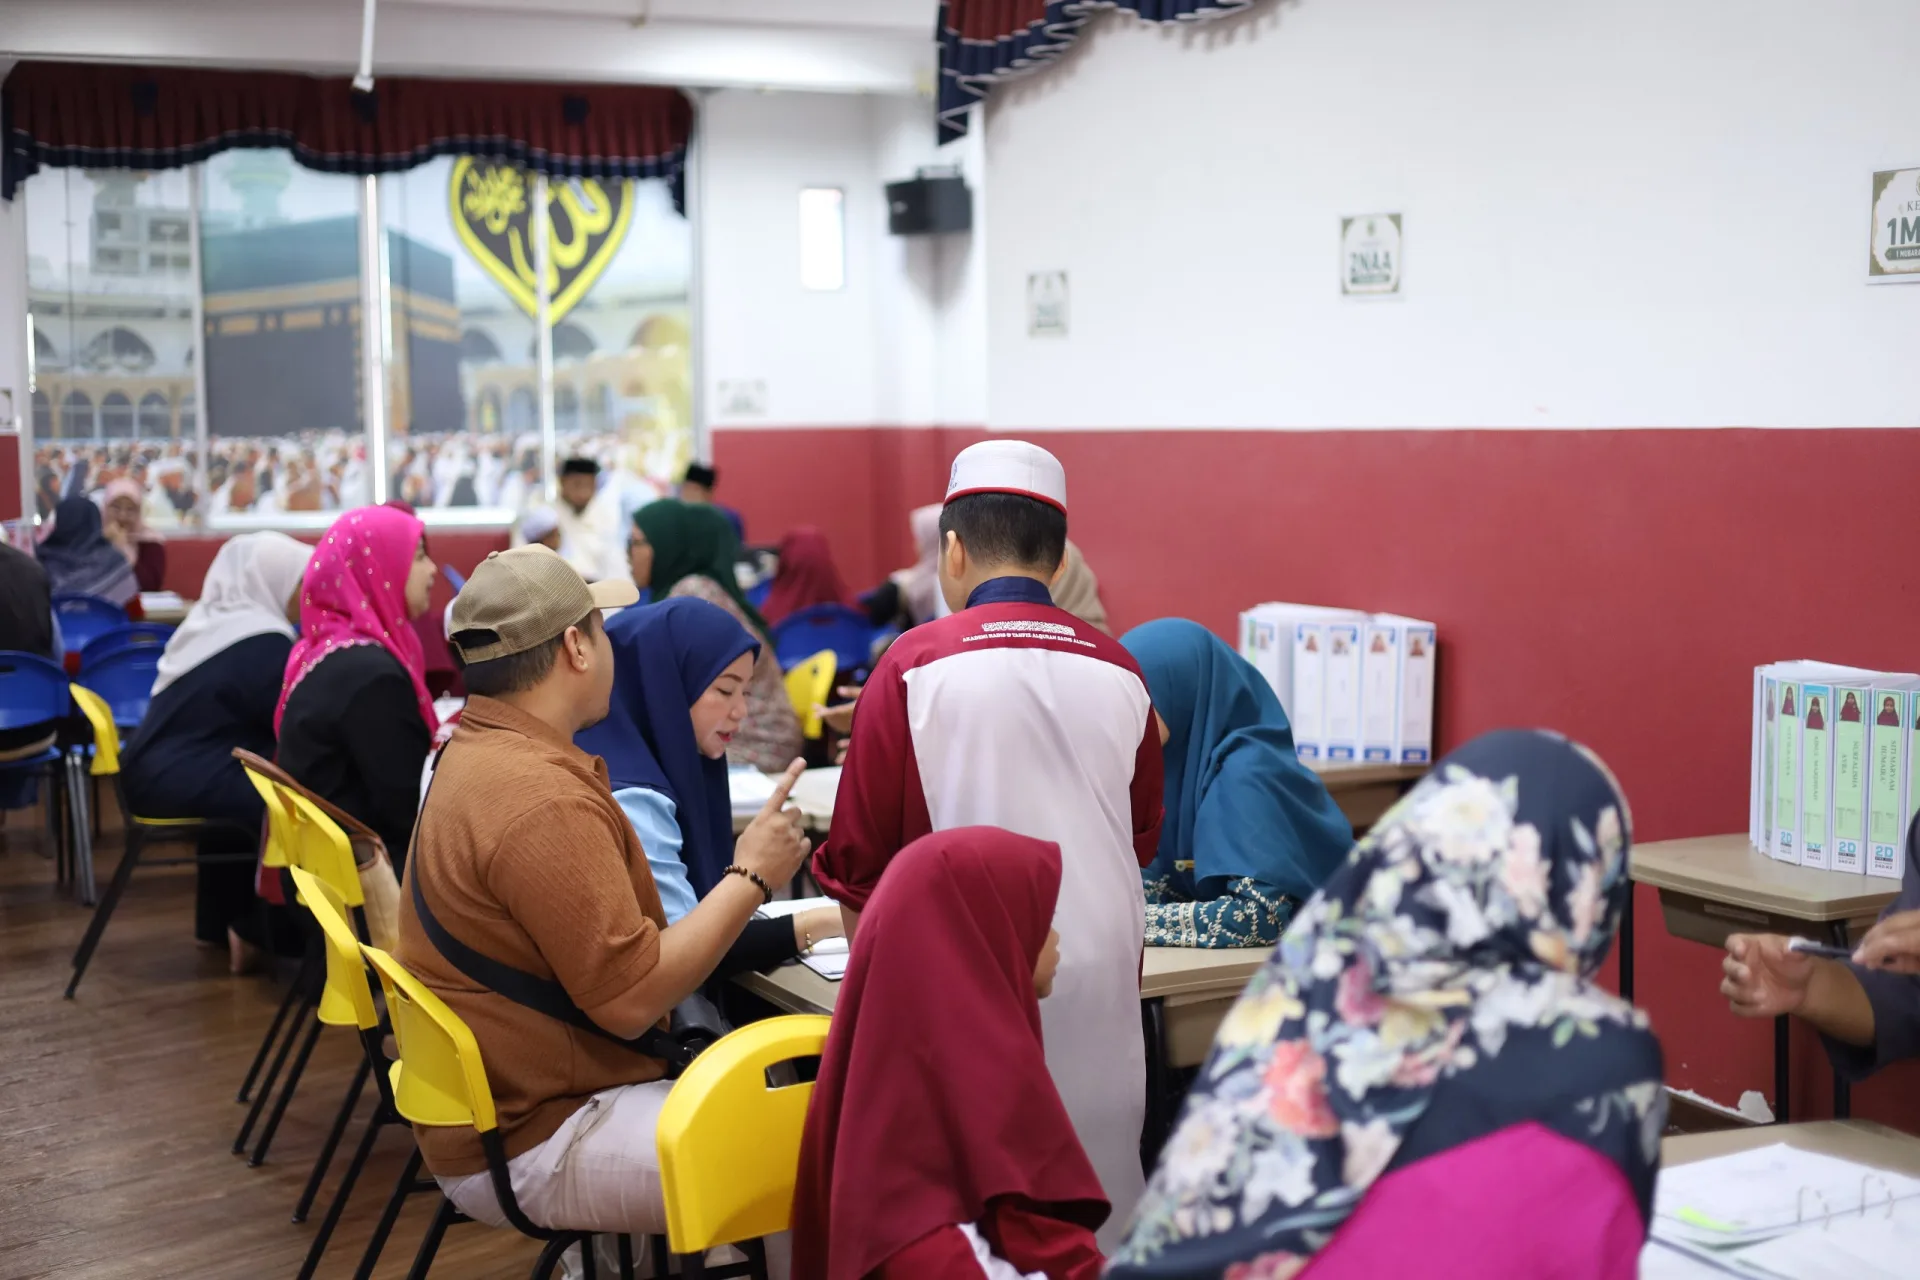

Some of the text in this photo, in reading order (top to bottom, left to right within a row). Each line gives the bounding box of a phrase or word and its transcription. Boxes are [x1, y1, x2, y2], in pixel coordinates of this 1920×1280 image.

[1887, 215, 1920, 246] 1M
[1888, 756, 1896, 791] MARYAM
[1839, 842, 1856, 853] 2D
[1876, 846, 1893, 858] 2D
